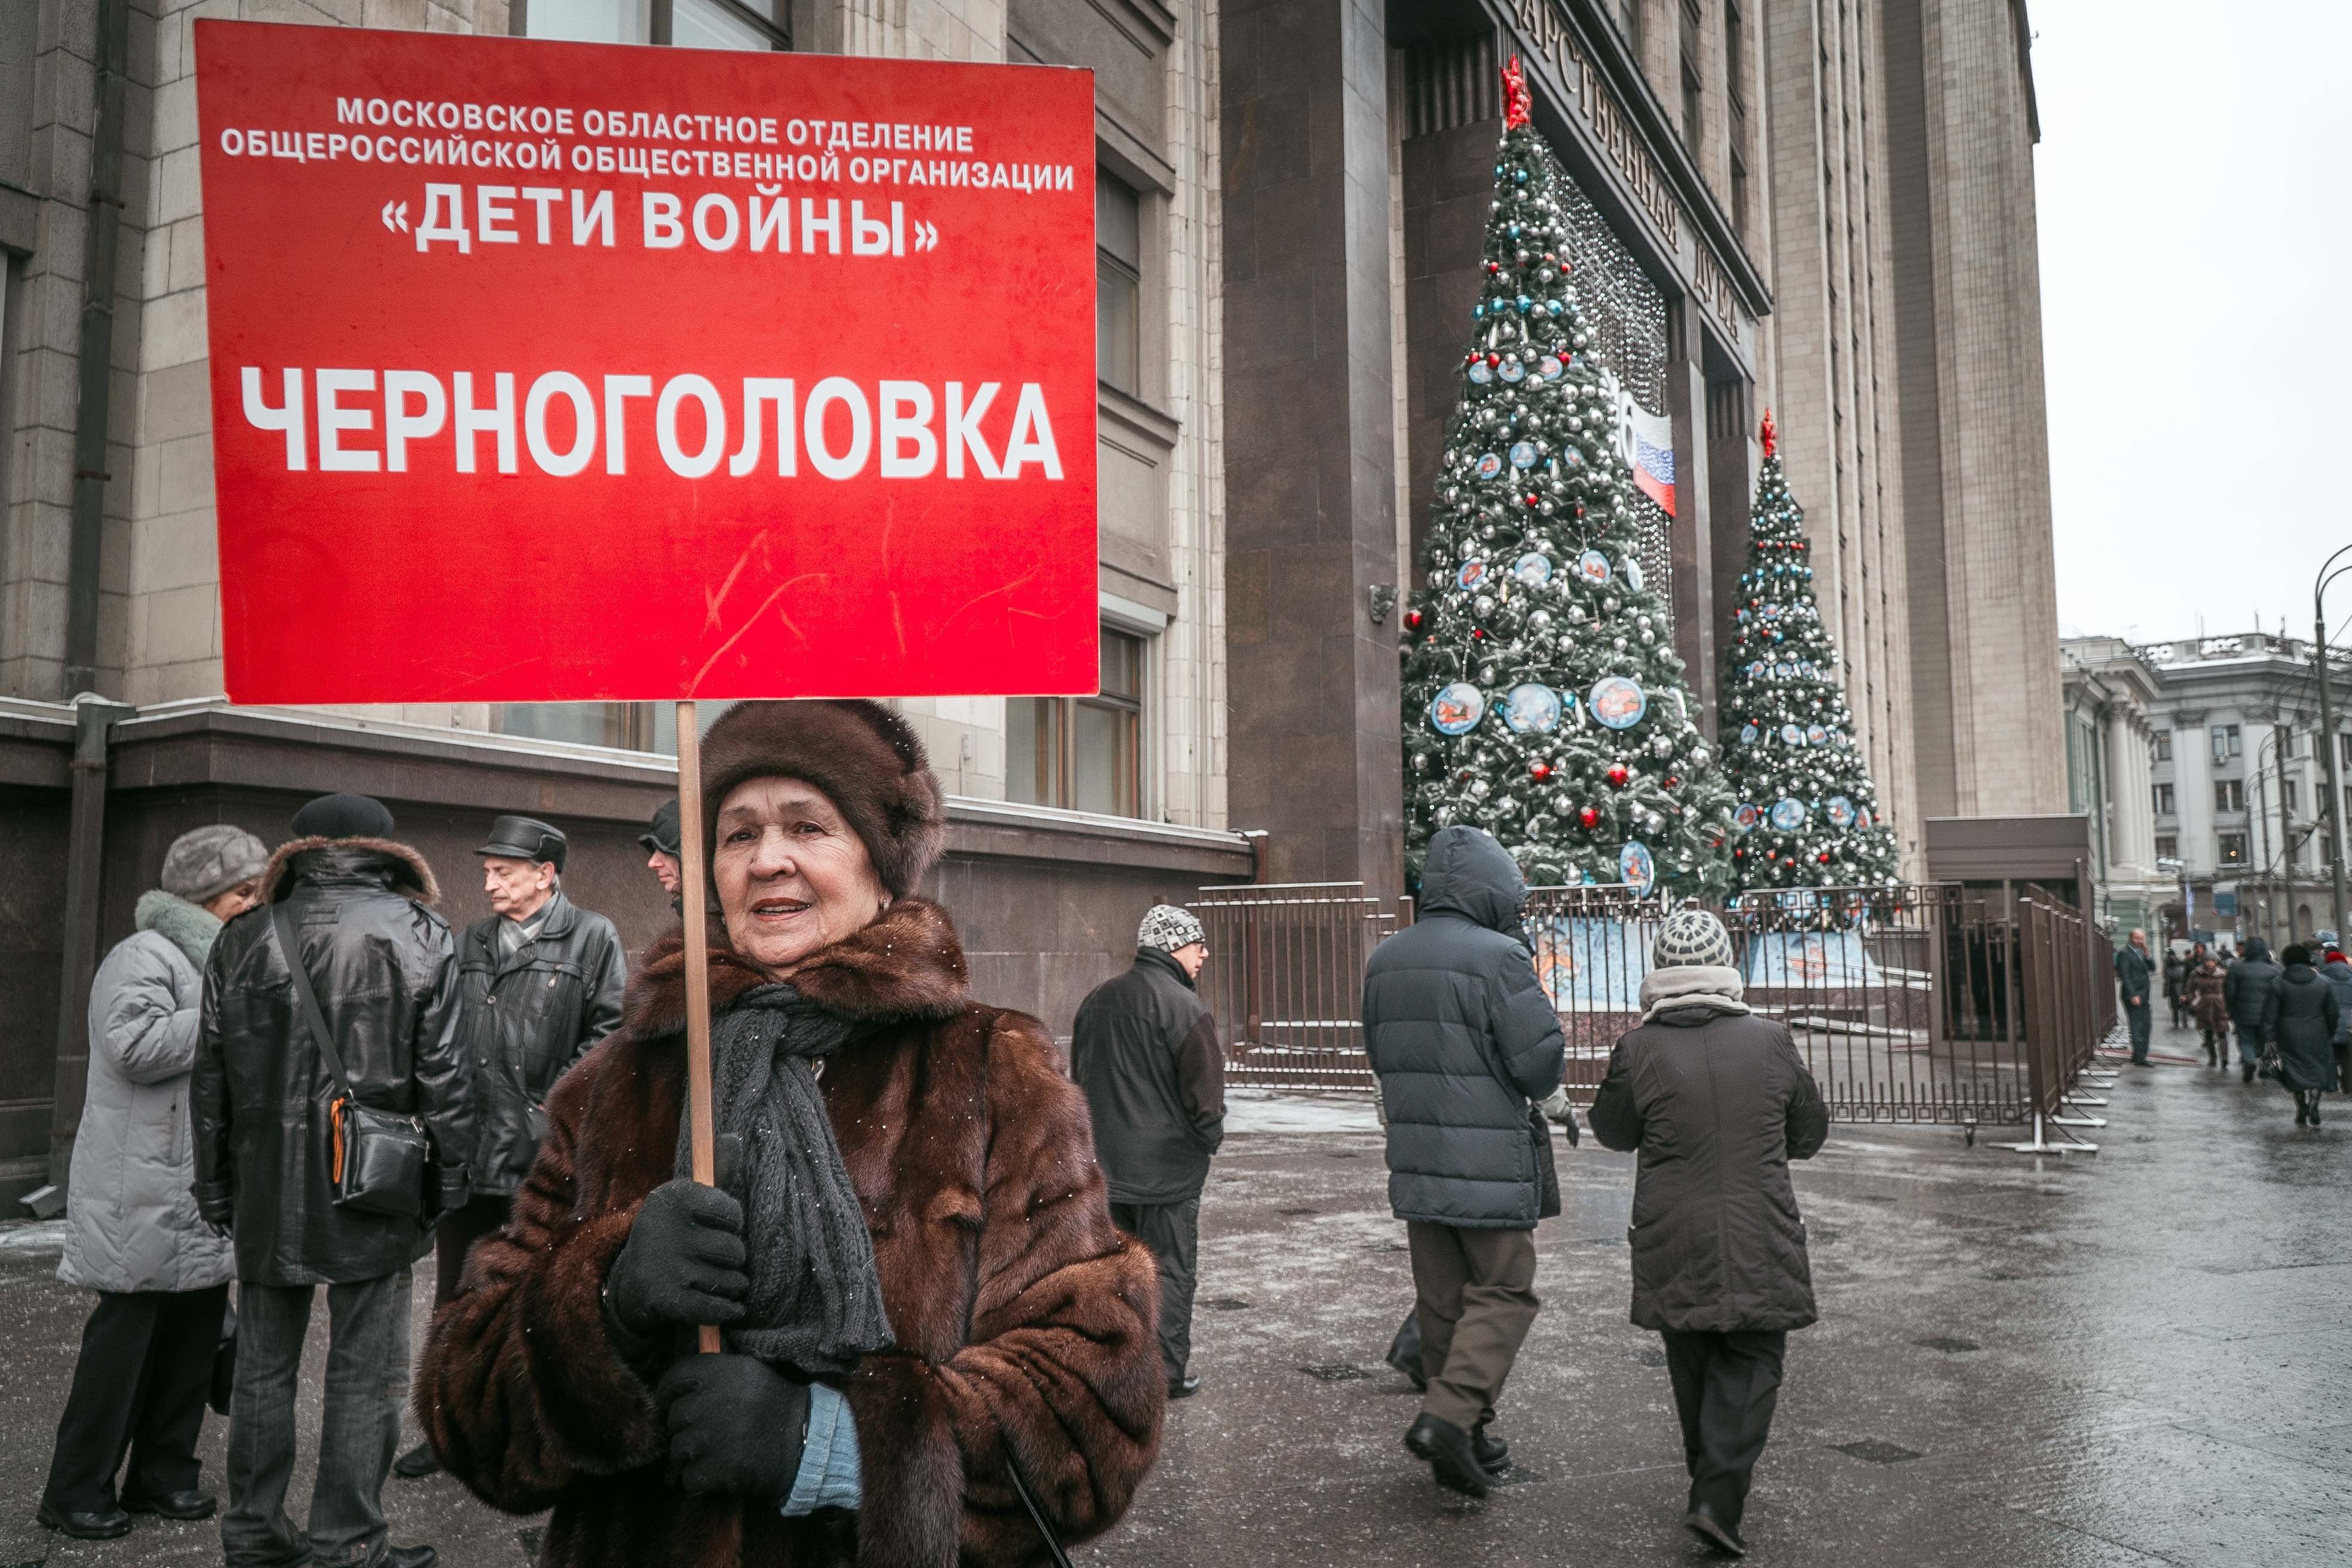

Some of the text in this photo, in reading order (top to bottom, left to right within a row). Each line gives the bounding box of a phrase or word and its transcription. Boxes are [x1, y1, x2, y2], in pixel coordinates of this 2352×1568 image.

[220, 128, 1074, 195] ОБЩЕРОССИЙСКОЙ ОБЩЕСТВЕННОЙ ОРГАНИЗАЦИИ
[336, 97, 973, 153] МОСКОВСКОЕ ОБЛАСТНОЕ ОТДЕЛЕНИЕ
[381, 183, 938, 258] «ДЕТИ ВОЙНЫ»
[1695, 241, 1741, 344] ДУМА
[240, 366, 1065, 481] ЧЕРНОГОЛОВКА
